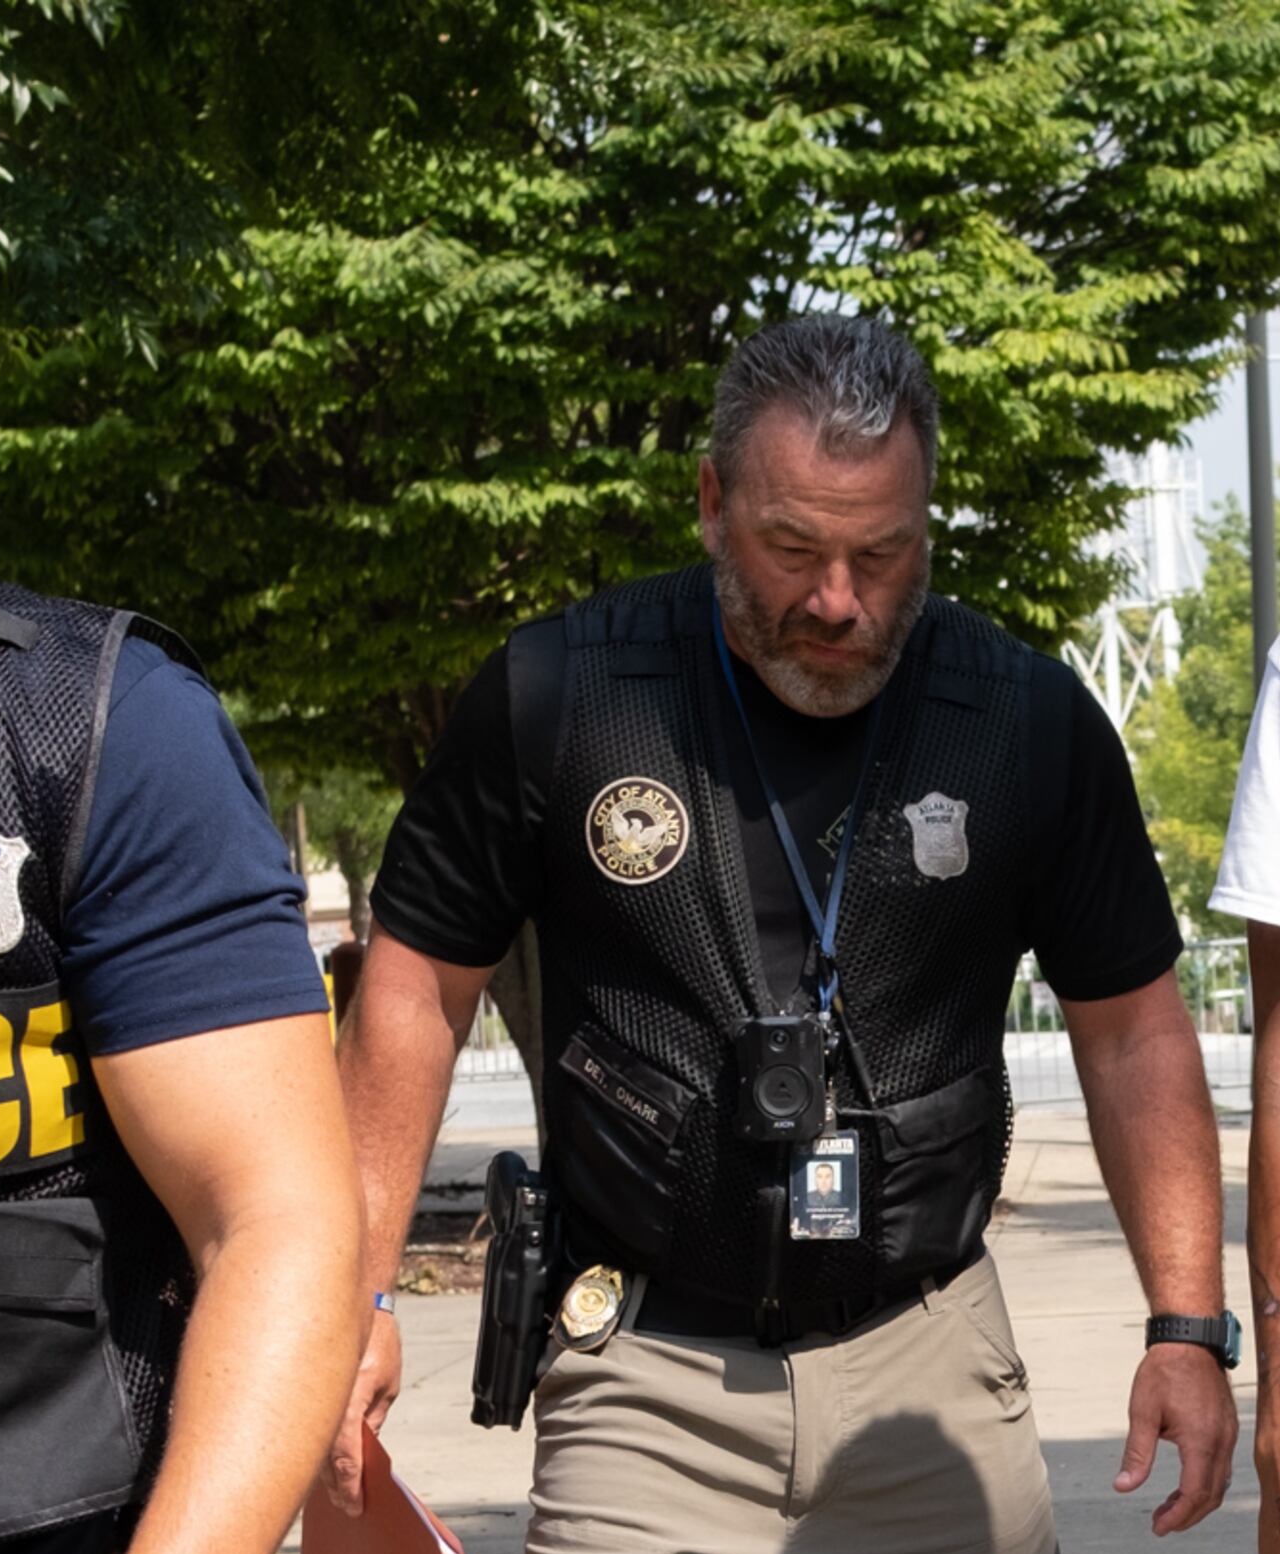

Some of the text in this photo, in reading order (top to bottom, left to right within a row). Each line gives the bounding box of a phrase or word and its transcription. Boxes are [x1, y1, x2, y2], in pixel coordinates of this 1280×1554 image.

[593, 792, 616, 827] CITY
[618, 785, 641, 800] OF
[641, 788, 680, 847] ATLANTA
[597, 845, 659, 876] POLICE
